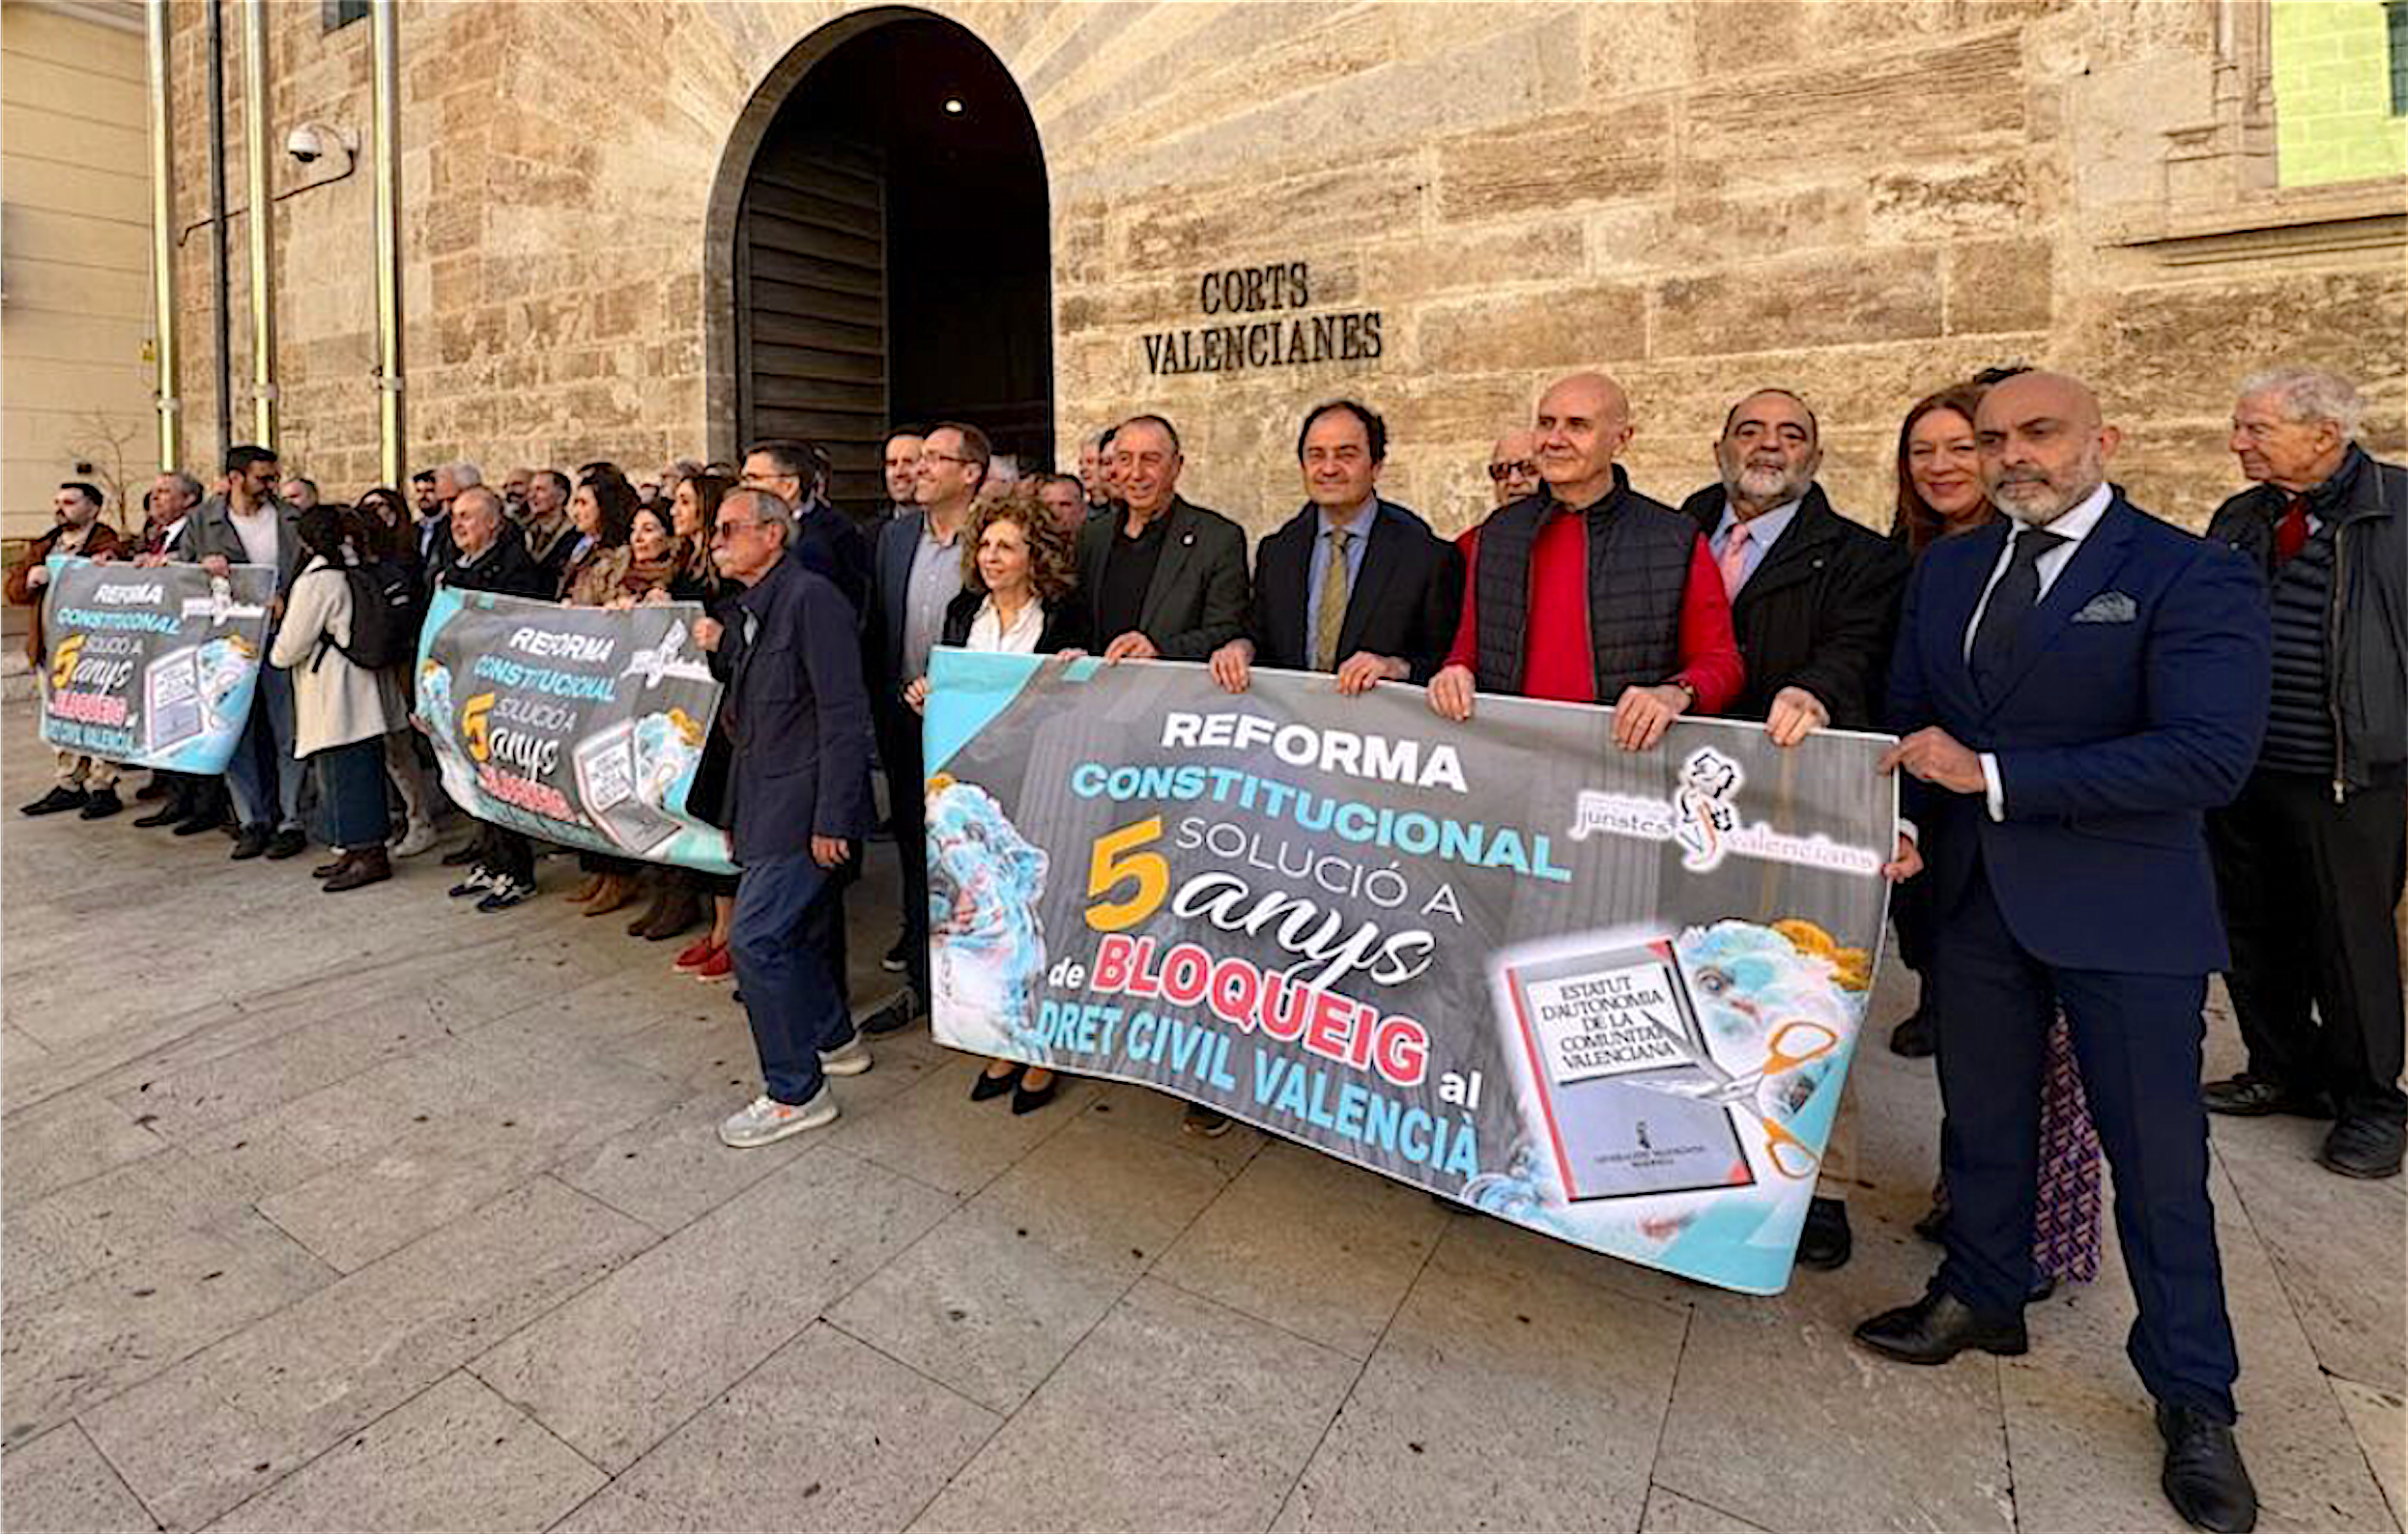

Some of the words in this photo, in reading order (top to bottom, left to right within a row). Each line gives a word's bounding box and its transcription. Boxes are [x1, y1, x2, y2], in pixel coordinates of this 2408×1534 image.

[1201, 262, 1308, 314] CORTS
[1142, 312, 1382, 375] VALENCIANES
[52, 634, 85, 689] 5
[72, 658, 132, 696] anys
[473, 655, 616, 702] CONSTUCIONAL
[461, 693, 495, 761] 5
[489, 727, 559, 781] anys
[565, 712, 578, 731] A
[1161, 711, 1469, 793] REFORMA
[1071, 763, 1572, 883] CONSTITUCIONAL
[1175, 816, 1408, 907] SOLUCIÓ
[1421, 884, 1464, 924] A
[1084, 815, 1170, 932] 5
[1172, 870, 1436, 997] anys
[1048, 956, 1085, 989] de
[1090, 933, 1430, 1086] BLOQUEIG
[1559, 977, 1633, 1001] ESTATUT
[1583, 1015, 1606, 1032] DE
[1609, 1012, 1634, 1028] LA
[1562, 1041, 1677, 1070] VALENCIANA
[1036, 1000, 1124, 1056] DRET
[1128, 1010, 1236, 1092] CIVIL
[1254, 1046, 1480, 1180] VALENCIÀ
[1439, 1069, 1482, 1110] al
